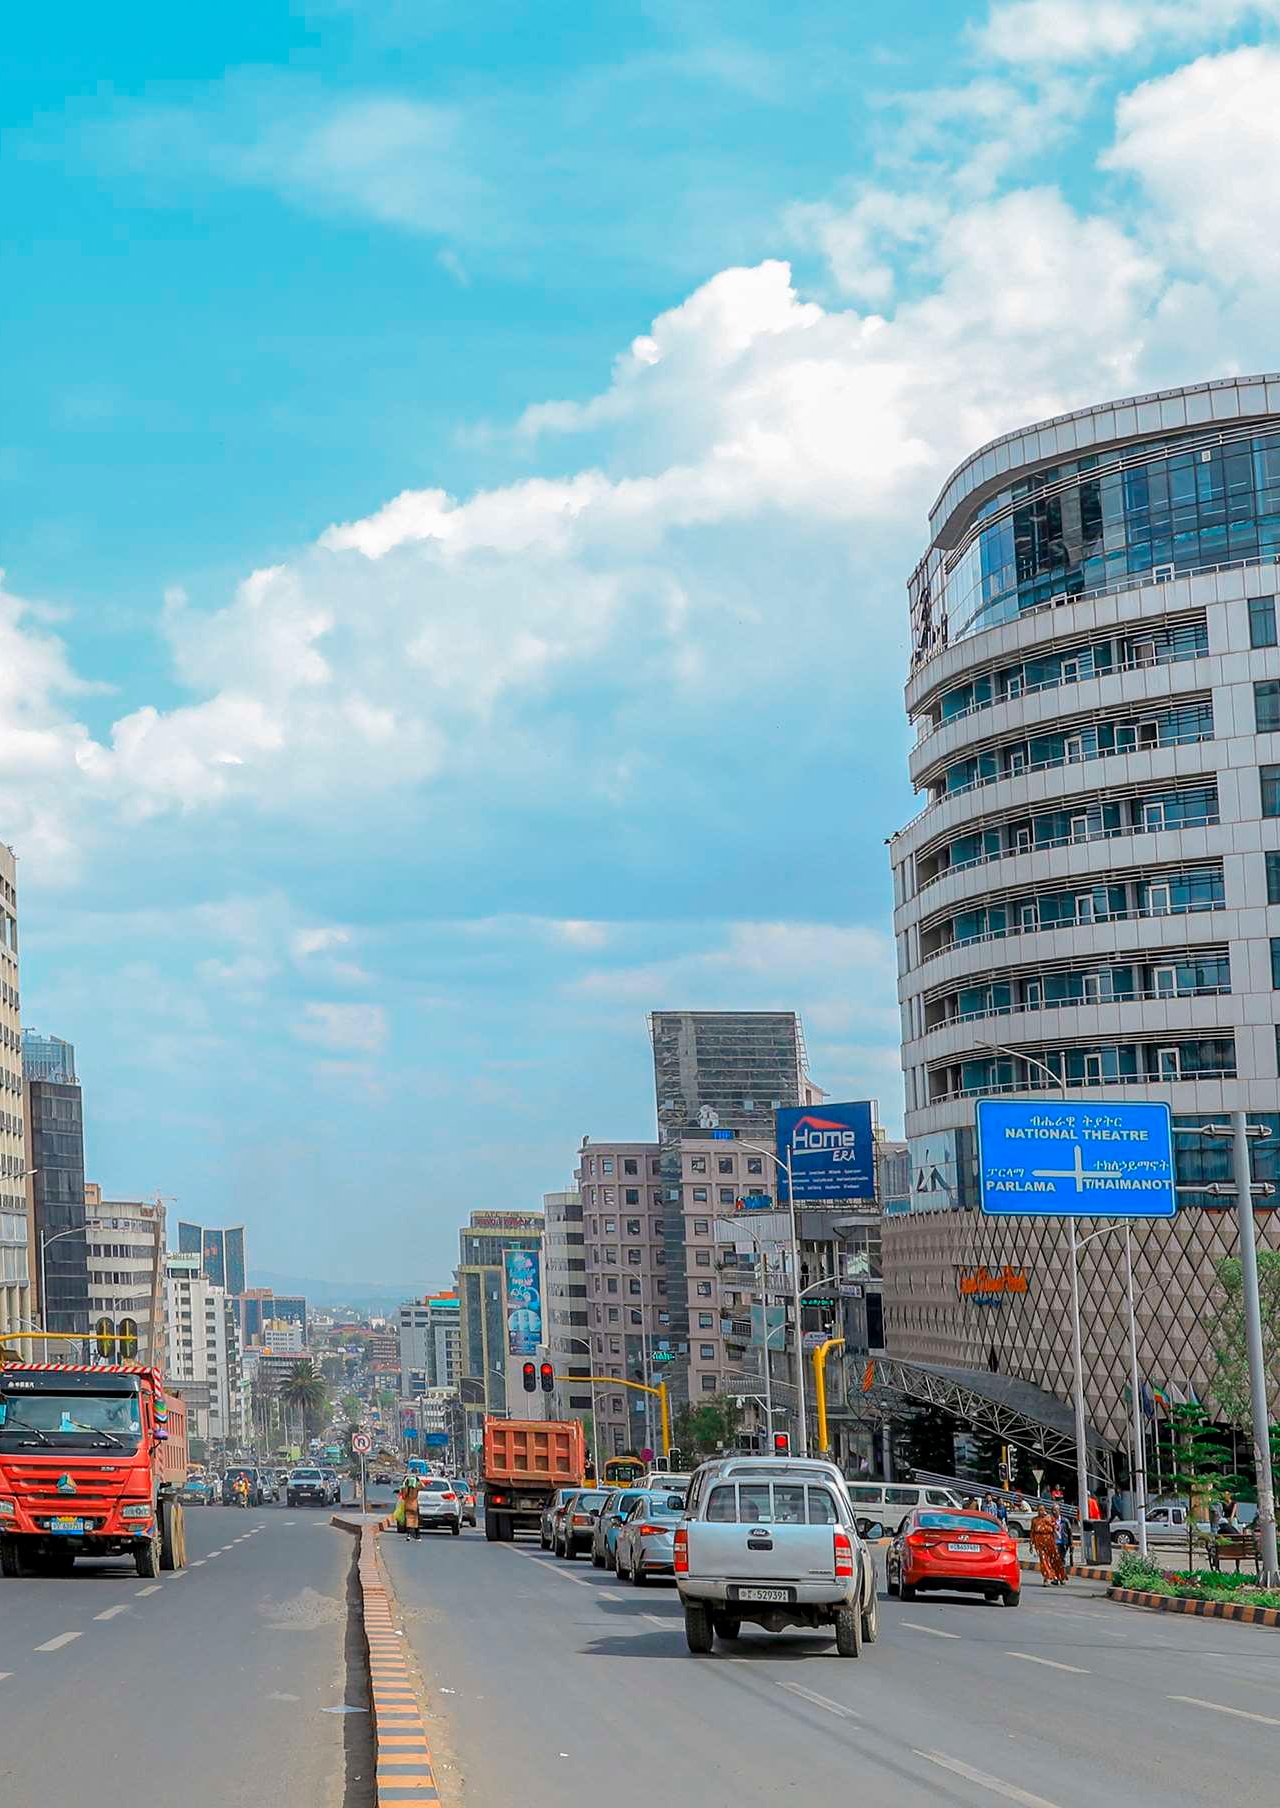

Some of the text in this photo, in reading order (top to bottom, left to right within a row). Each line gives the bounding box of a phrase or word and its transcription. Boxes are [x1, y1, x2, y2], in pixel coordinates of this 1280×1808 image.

[792, 1128, 855, 1149] Home
[1005, 1127, 1149, 1141] NATIONAL THEATRE
[832, 1149, 856, 1162] ERA
[985, 1180, 1056, 1192] PARLAMA
[1083, 1178, 1172, 1191] T/HAIMANOT
